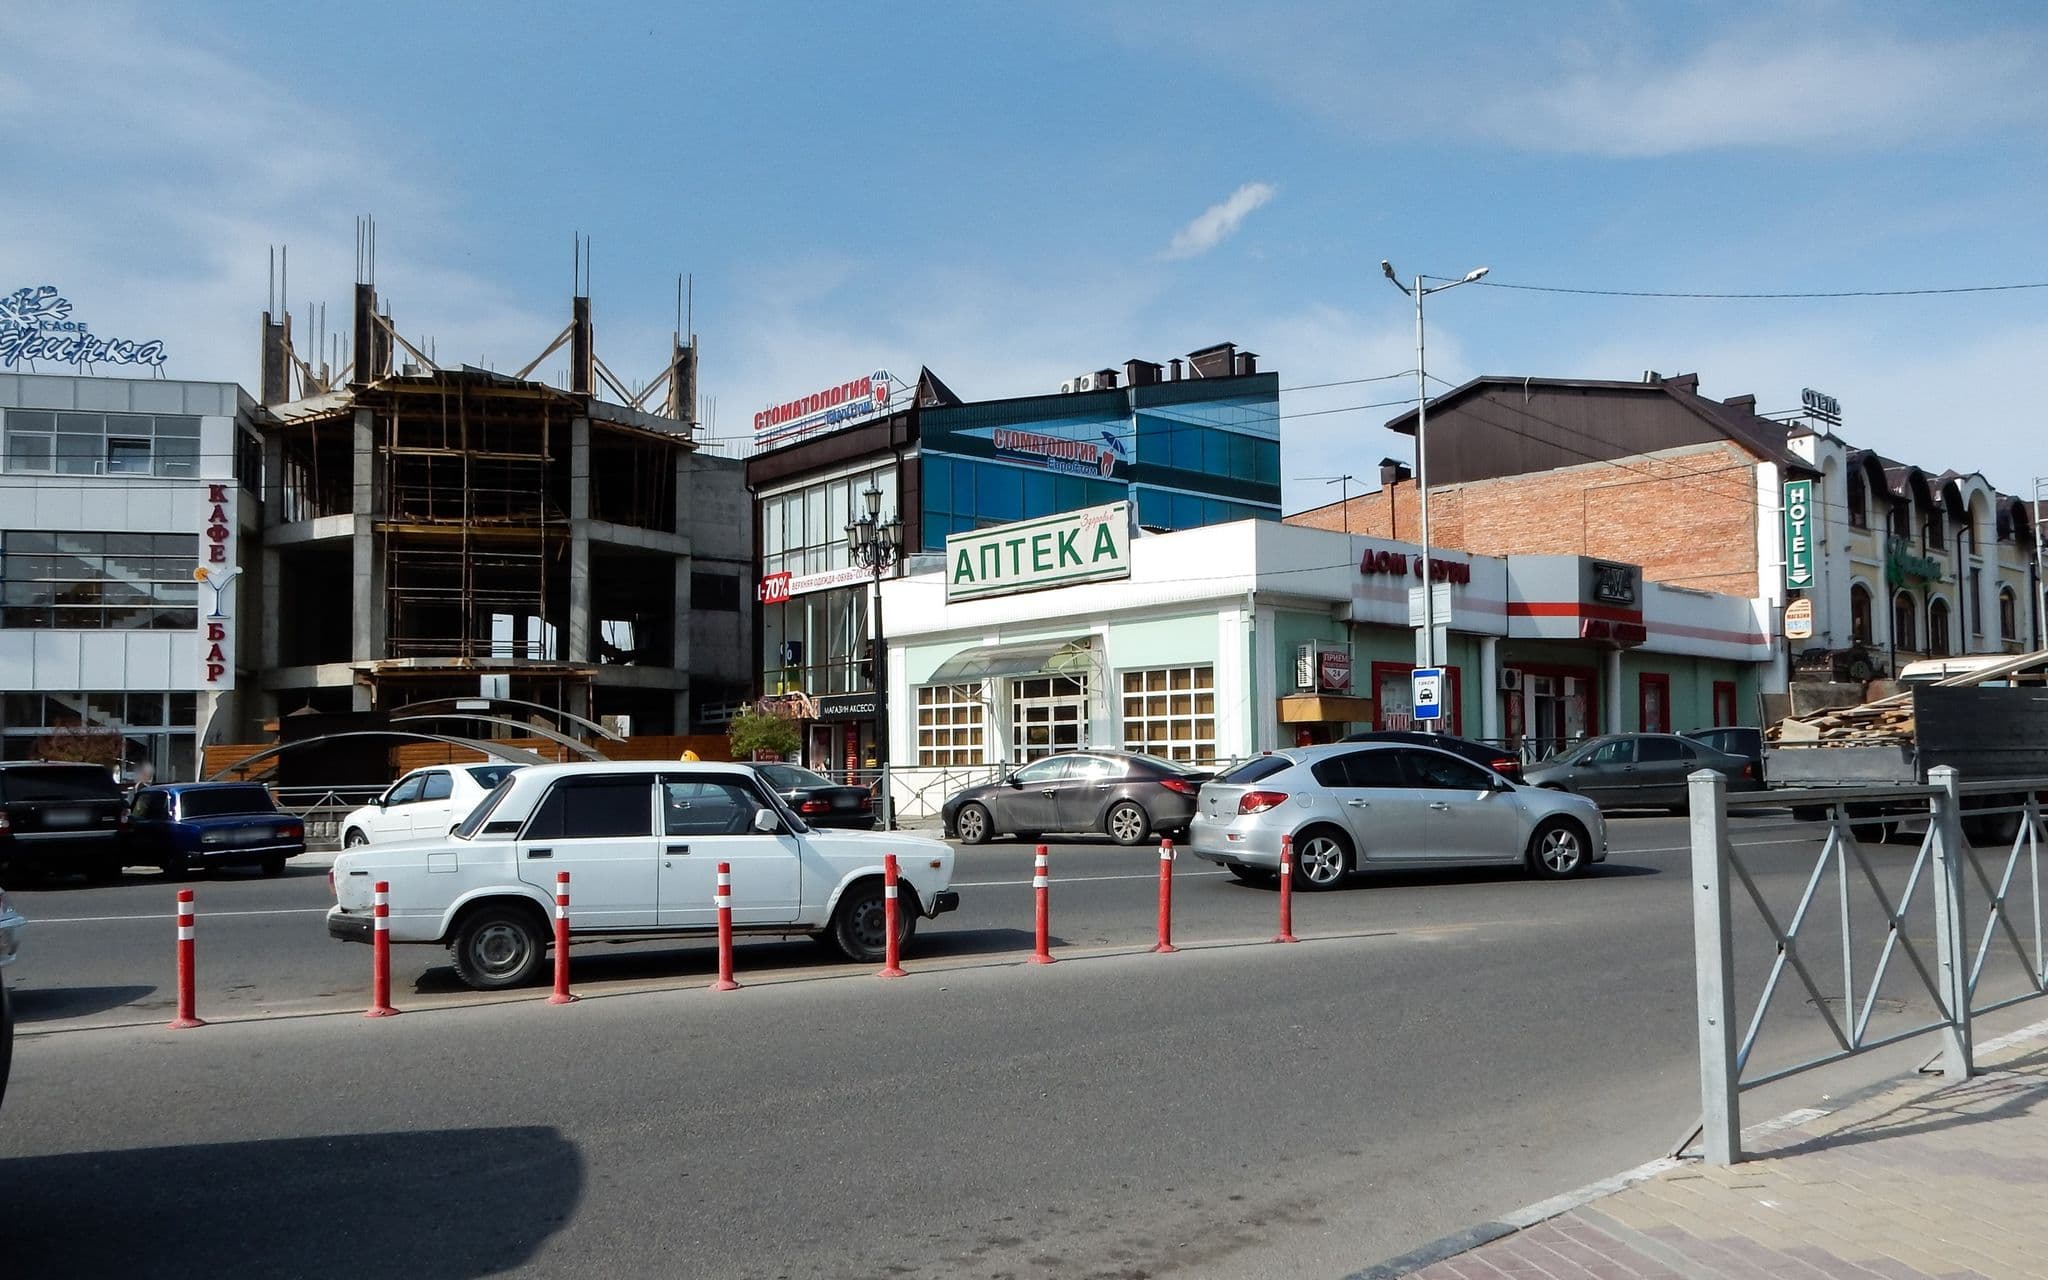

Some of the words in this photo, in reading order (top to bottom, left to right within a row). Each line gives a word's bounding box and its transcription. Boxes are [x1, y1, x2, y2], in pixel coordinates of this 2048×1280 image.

[39, 320, 88, 332] КАФЕ
[0, 329, 168, 367] жинка
[754, 376, 871, 431] СТОМАТОЛОГИЯ
[1802, 388, 1841, 415] ОТЕЛЬ
[993, 428, 1098, 464] СТОМАТОЛОГИЯ
[1047, 457, 1098, 477] ЕвроСтом
[206, 484, 230, 563] КАФЕ
[1790, 487, 1806, 569] HOTEL
[954, 523, 1118, 585] АПТЕКА
[761, 575, 788, 601] -70%
[206, 622, 225, 682] БАР
[824, 704, 849, 714] МАГАЗИН
